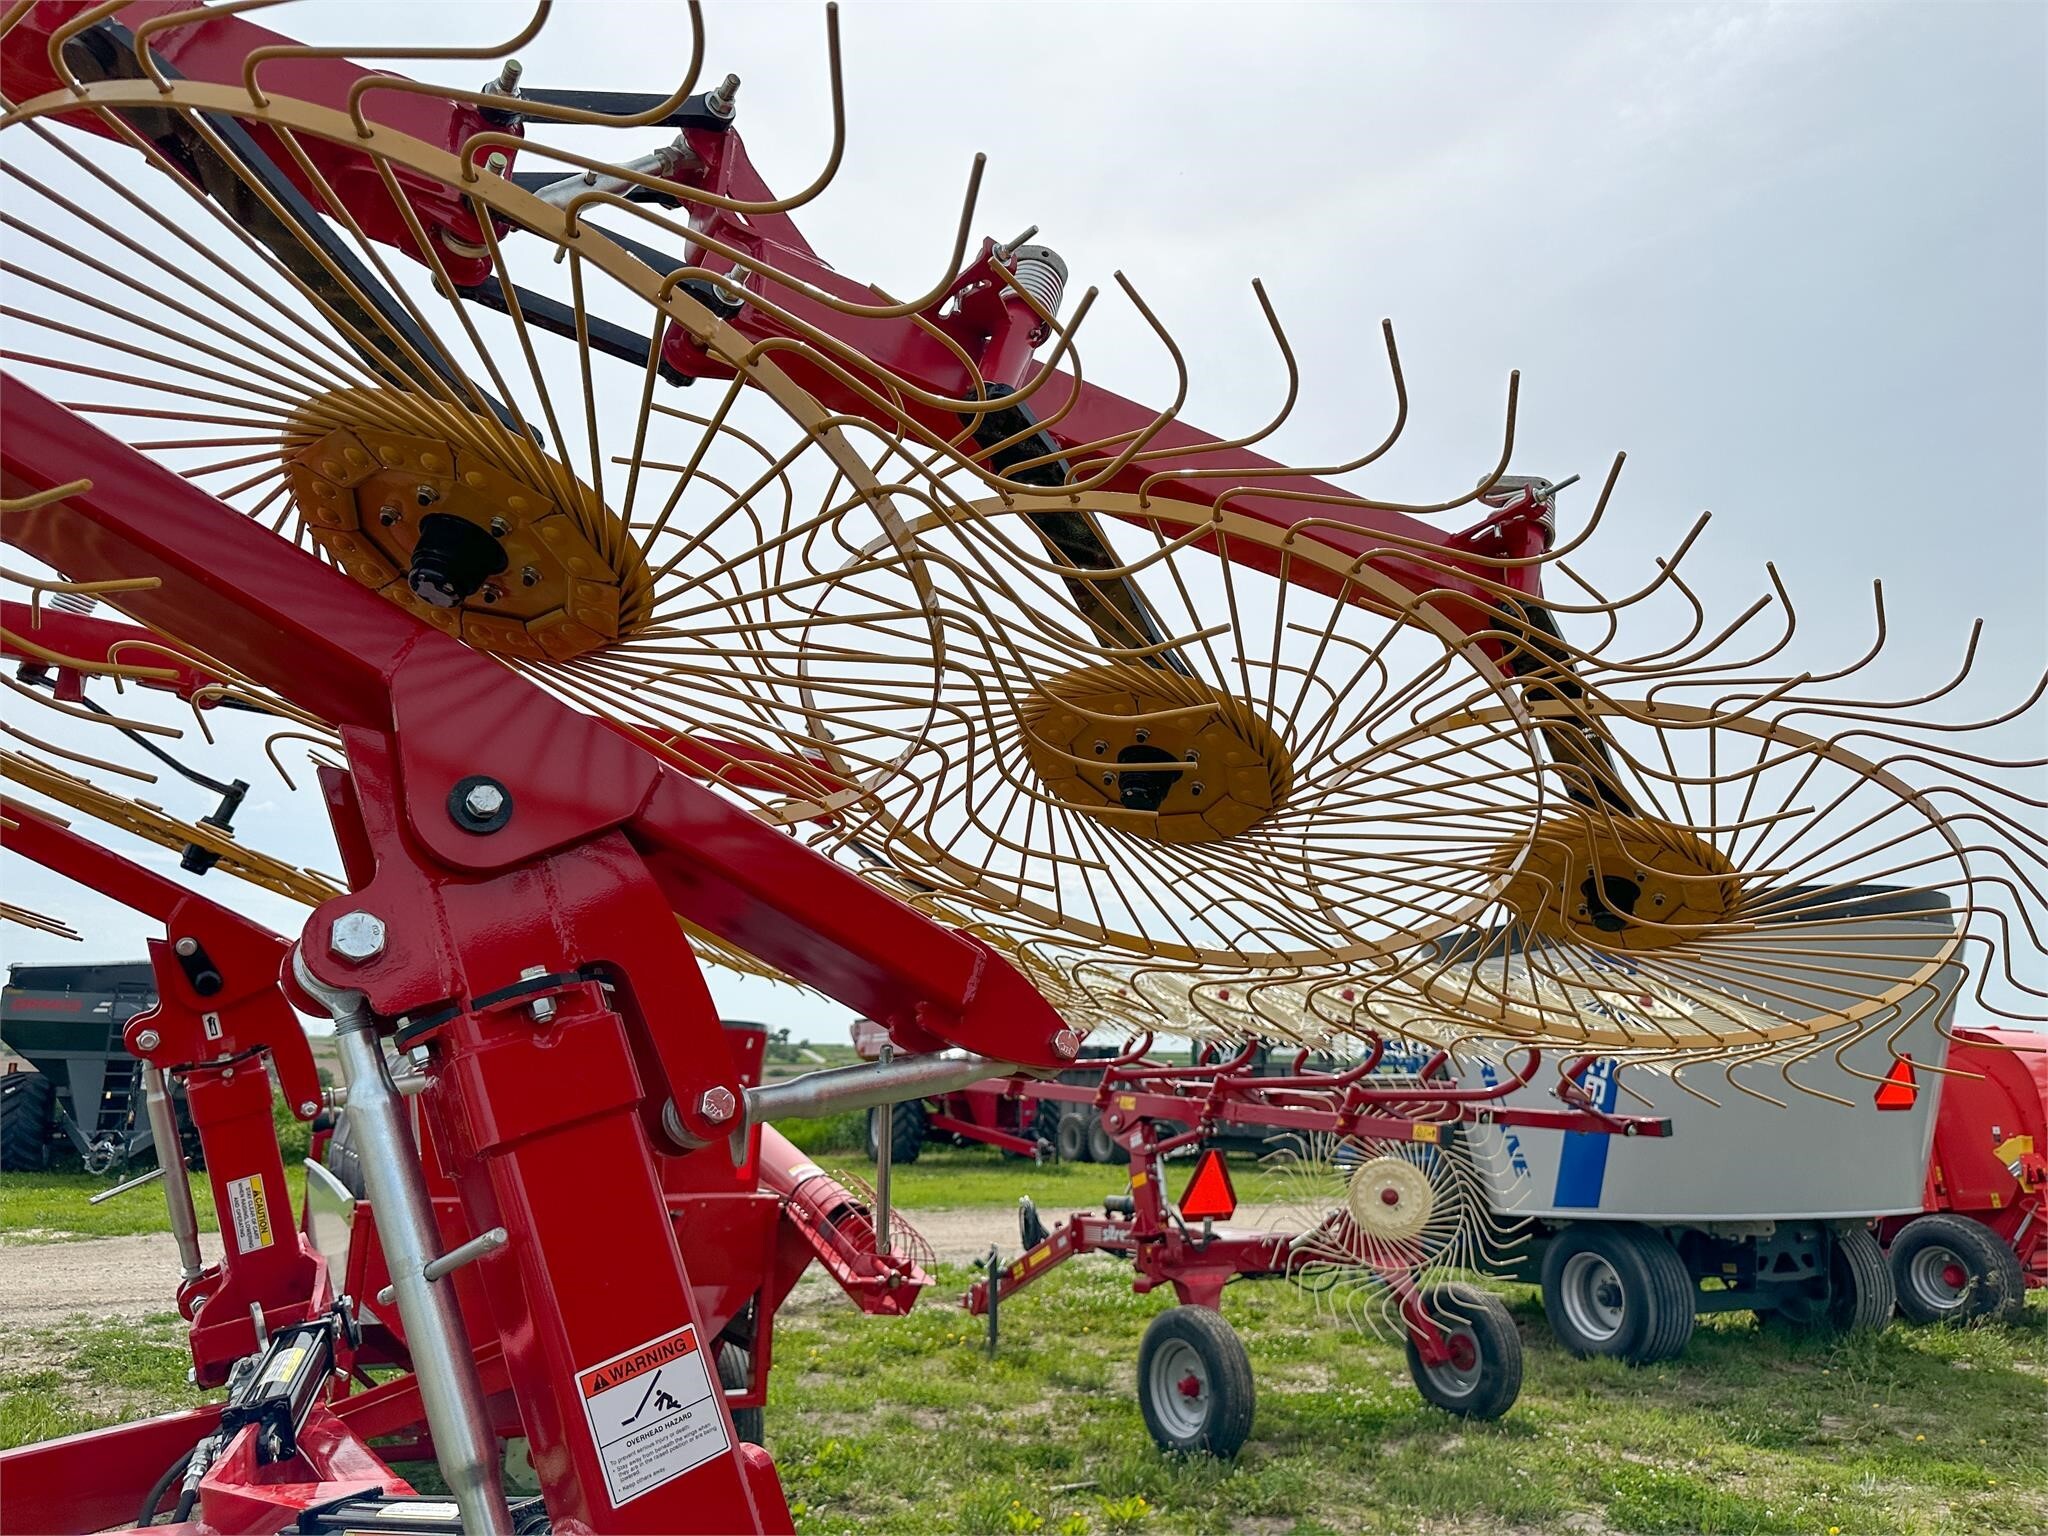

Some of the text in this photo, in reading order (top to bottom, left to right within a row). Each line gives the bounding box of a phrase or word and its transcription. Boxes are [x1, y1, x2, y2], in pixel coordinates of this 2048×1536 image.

[248, 1200, 256, 1218] CLEAR
[255, 1197, 267, 1233] CAUTION
[608, 1338, 686, 1381] WARNING
[617, 1464, 628, 1472] Stay
[629, 1457, 642, 1466] away
[642, 1451, 654, 1459] from
[654, 1441, 675, 1453] beneath
[684, 1430, 698, 1440] wings
[698, 1423, 711, 1432] when
[626, 1412, 693, 1448] OVERHEAD HAZARD
[617, 1452, 636, 1463] prevent
[636, 1442, 655, 1453] serious
[655, 1435, 669, 1445] injury
[618, 1470, 630, 1478] they
[653, 1450, 669, 1460] raised
[669, 1441, 689, 1453] position
[703, 1427, 717, 1436] being
[622, 1482, 636, 1492] Keep
[636, 1474, 652, 1484] others
